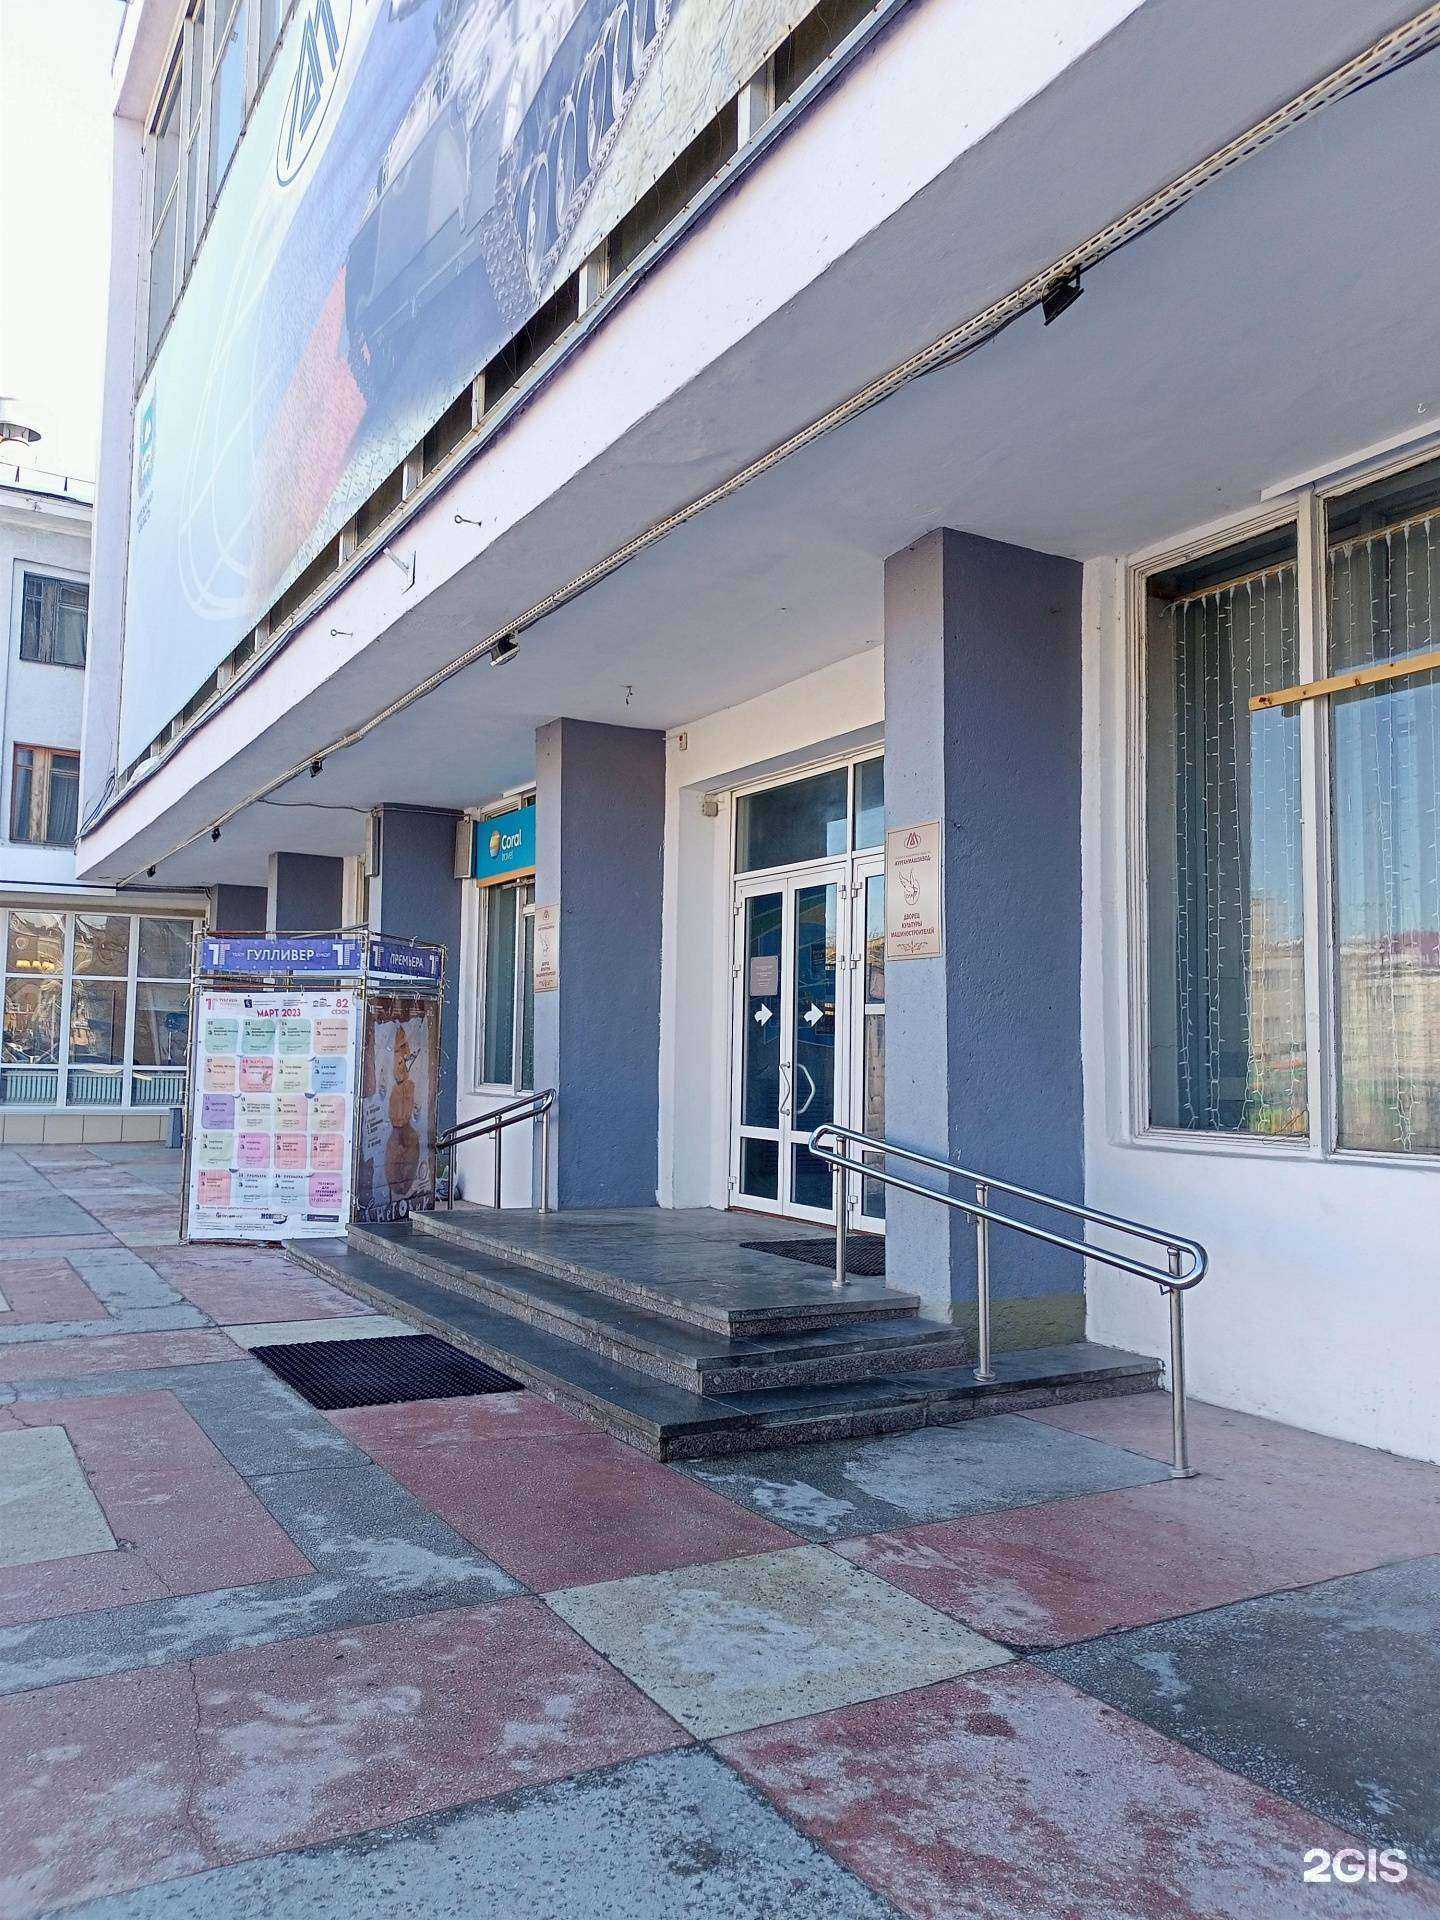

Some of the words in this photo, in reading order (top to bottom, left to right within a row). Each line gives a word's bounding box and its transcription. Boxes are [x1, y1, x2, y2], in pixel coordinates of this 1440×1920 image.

[501, 828, 522, 850] Coral
[246, 949, 315, 961] ГУЛЛИВЕР
[389, 953, 424, 968] ПРЕМЬЕРА
[336, 998, 349, 1008] 82
[257, 1008, 279, 1018] МАРТ
[281, 1008, 301, 1017] 2023
